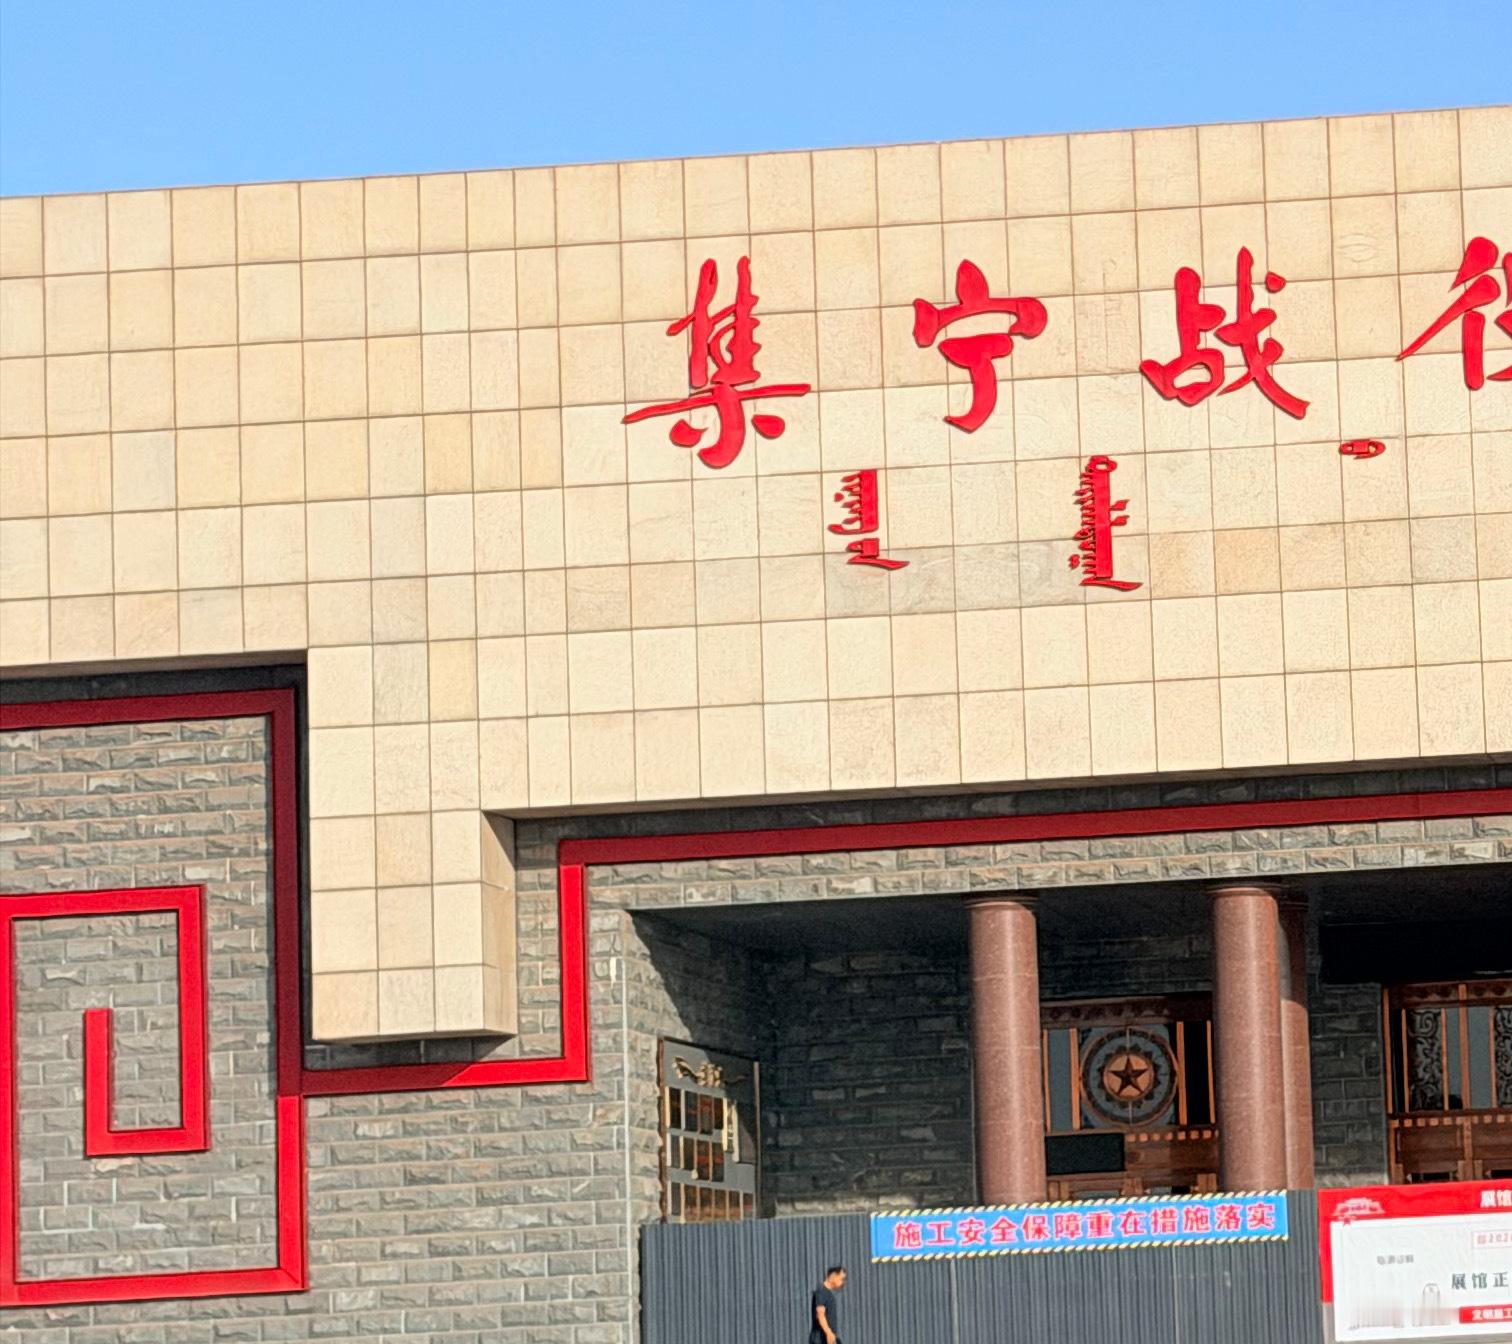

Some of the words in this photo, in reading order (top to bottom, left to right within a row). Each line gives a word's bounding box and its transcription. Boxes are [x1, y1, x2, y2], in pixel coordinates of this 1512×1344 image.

[893, 1201, 1276, 1249] 施工安全保障重在措施落实
